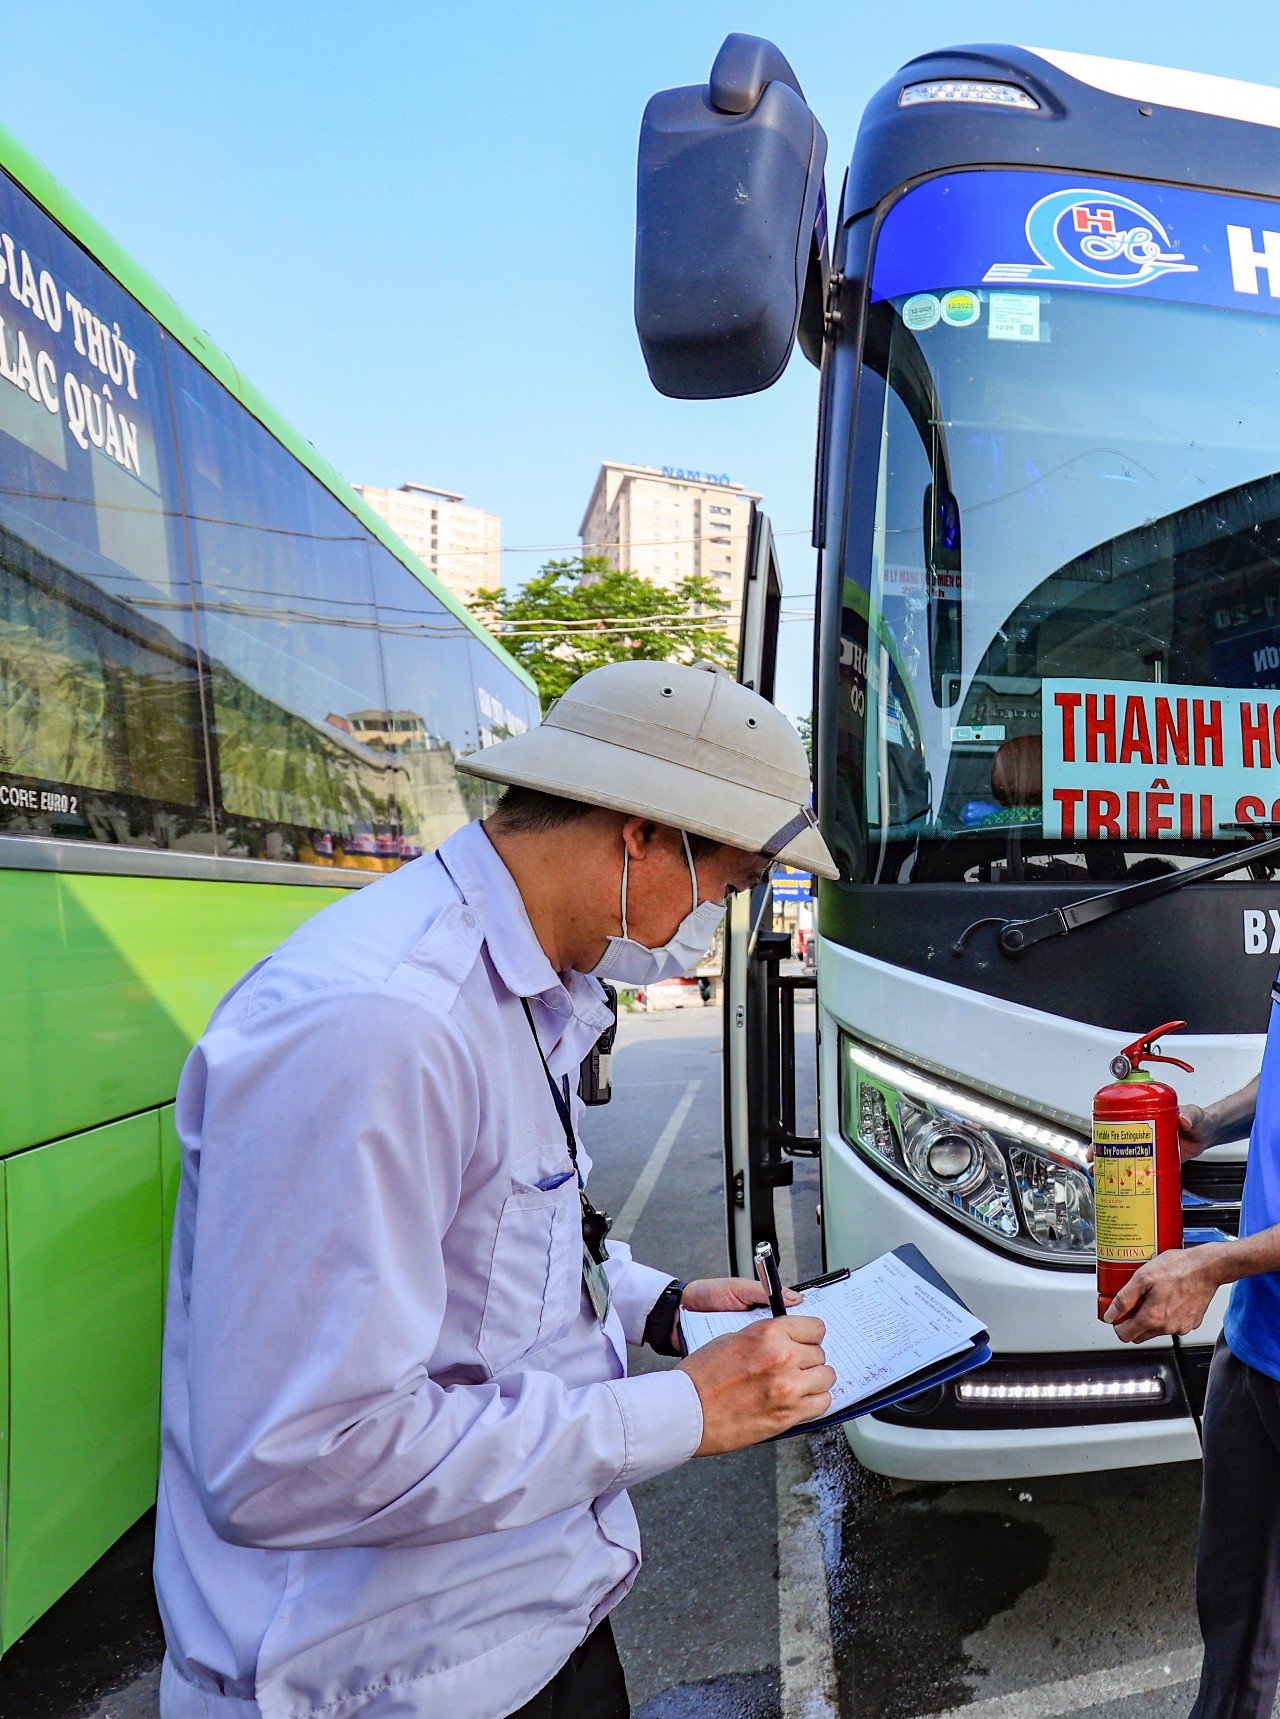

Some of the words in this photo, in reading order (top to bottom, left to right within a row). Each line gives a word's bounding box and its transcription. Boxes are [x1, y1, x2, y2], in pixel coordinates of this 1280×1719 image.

[66, 291, 138, 400] THỦY
[64, 372, 140, 477] QUÂN
[1054, 692, 1224, 768] THANH
[41, 791, 69, 813] EURO
[70, 796, 78, 814] 2
[1121, 1130, 1151, 1142] Extinguisher
[1106, 1248, 1114, 1257] IN
[1117, 1248, 1145, 1258] CHINA
